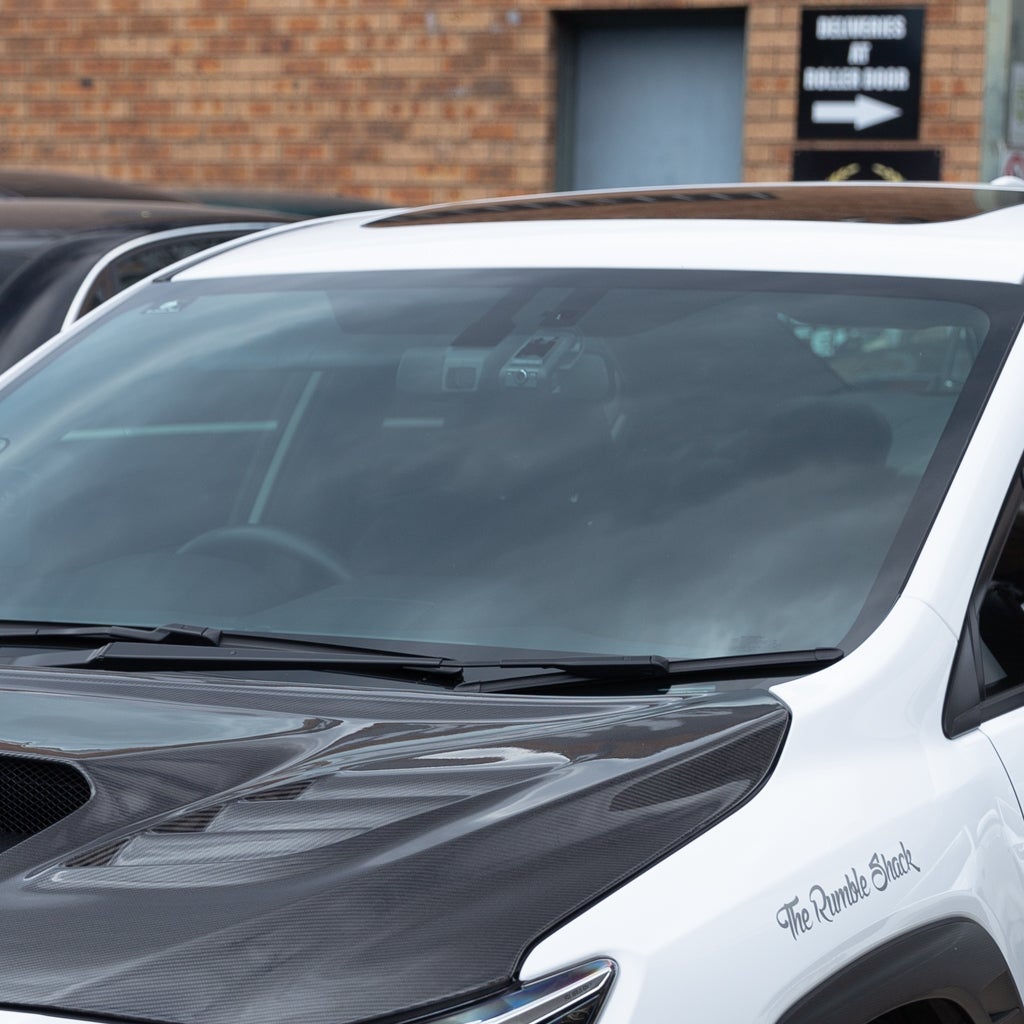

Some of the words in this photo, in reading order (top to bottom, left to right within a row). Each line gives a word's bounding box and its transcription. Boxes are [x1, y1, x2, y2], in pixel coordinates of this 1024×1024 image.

[776, 896, 813, 941] The
[809, 867, 870, 923] Rumble
[868, 841, 921, 892] Shack
